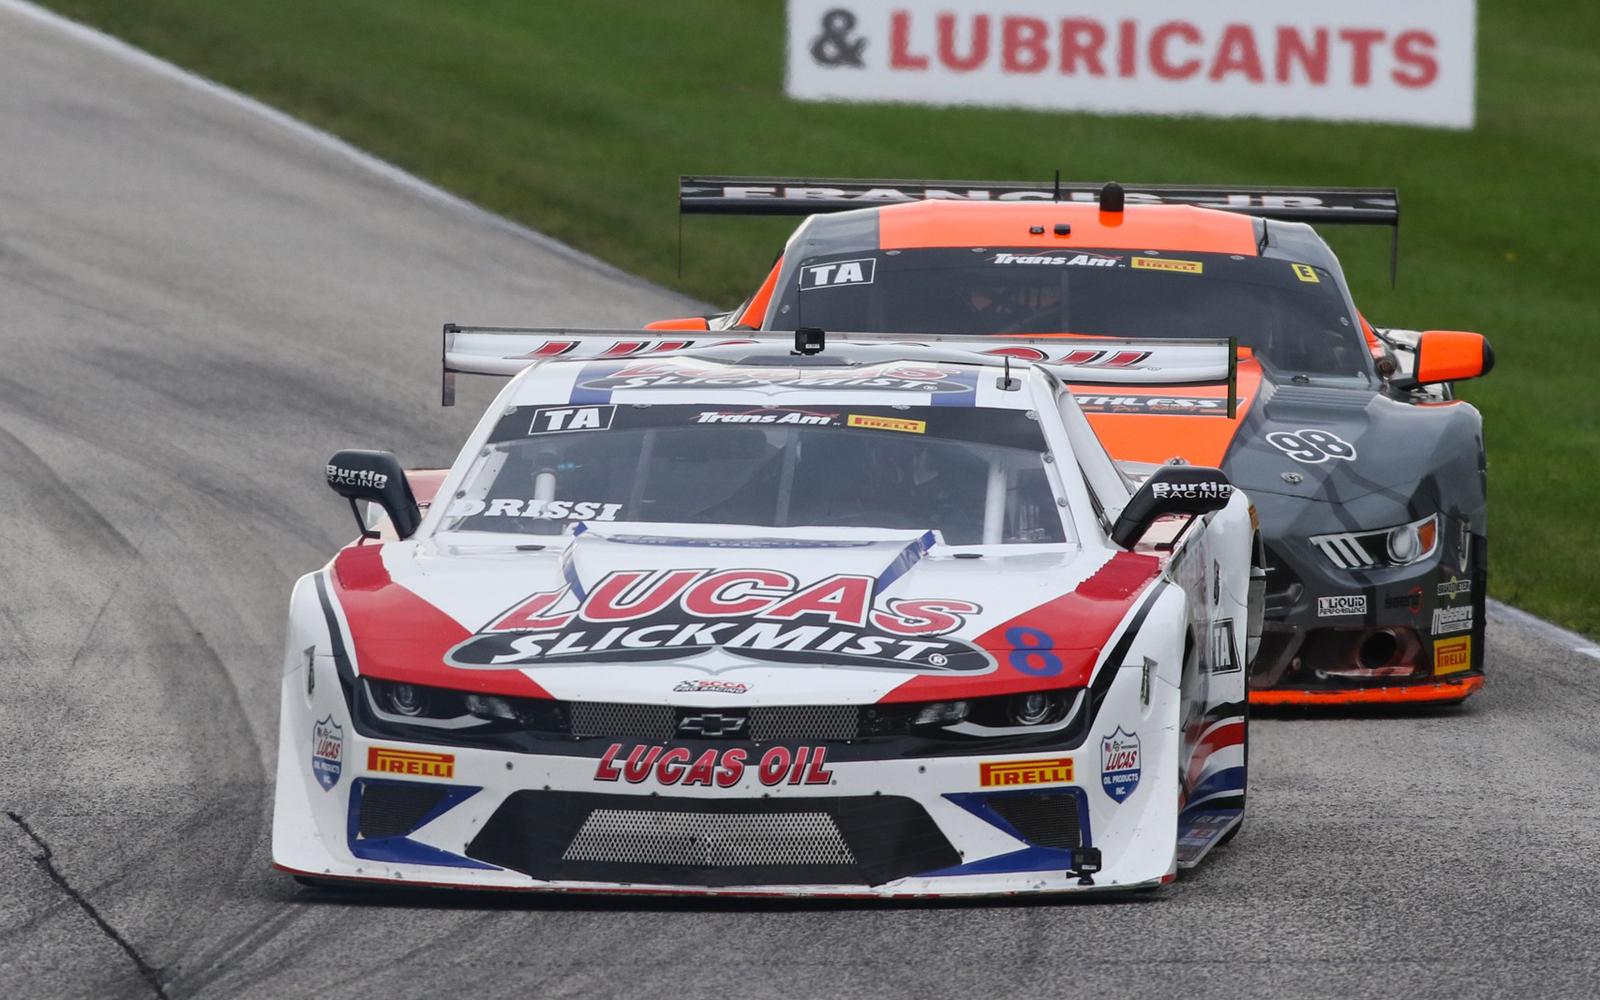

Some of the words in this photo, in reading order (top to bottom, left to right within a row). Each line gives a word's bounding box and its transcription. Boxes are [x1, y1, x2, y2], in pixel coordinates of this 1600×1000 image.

[809, 8, 868, 70] &
[888, 10, 1440, 90] LUBRICANTS
[994, 253, 1066, 265] Trans
[1066, 254, 1117, 268] Am
[810, 263, 864, 285] TA
[1297, 265, 1313, 278] E
[544, 408, 601, 430] TA
[697, 411, 777, 425] Trans
[777, 412, 832, 426] Am
[854, 416, 920, 431] PIRELLI
[1266, 429, 1357, 464] 98
[326, 464, 389, 482] Burtin
[327, 475, 386, 489] RACING
[1152, 481, 1232, 493] Burtin
[1153, 489, 1231, 499] RACING
[447, 498, 623, 521] DRISSI
[474, 567, 984, 637] LUCAS
[1004, 626, 1064, 677] 8
[1437, 640, 1467, 669] PIRELLI
[316, 741, 341, 760] LUCAS
[1106, 751, 1137, 770] LUCAS
[367, 747, 456, 778] PIRELLI
[594, 742, 748, 788] LUCAS
[758, 745, 833, 786] OIL
[979, 757, 1074, 787] PIRELLI
[1104, 777, 1112, 785] OIL
[1113, 774, 1138, 783] PRODUCTS
